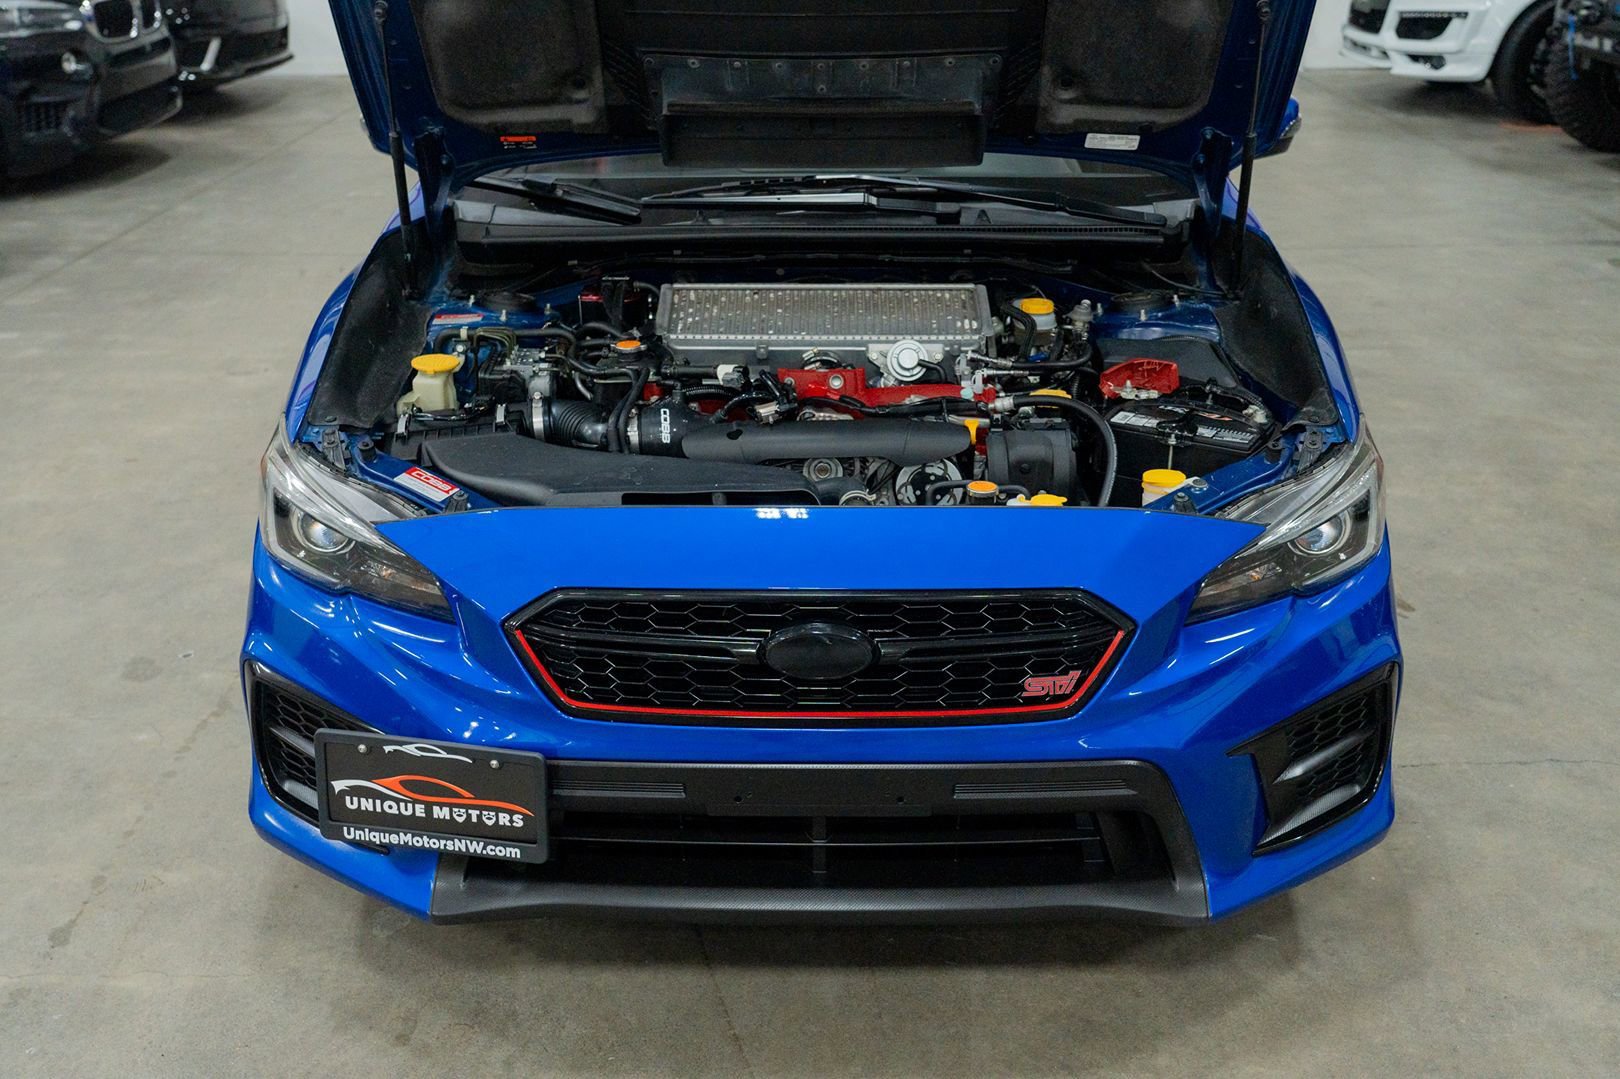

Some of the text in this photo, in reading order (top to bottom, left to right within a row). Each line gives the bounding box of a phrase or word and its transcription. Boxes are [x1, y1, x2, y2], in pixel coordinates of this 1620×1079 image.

[345, 796, 524, 828] UNIQUE MOTORS
[343, 827, 521, 859] UniqueMotorsNW.com
